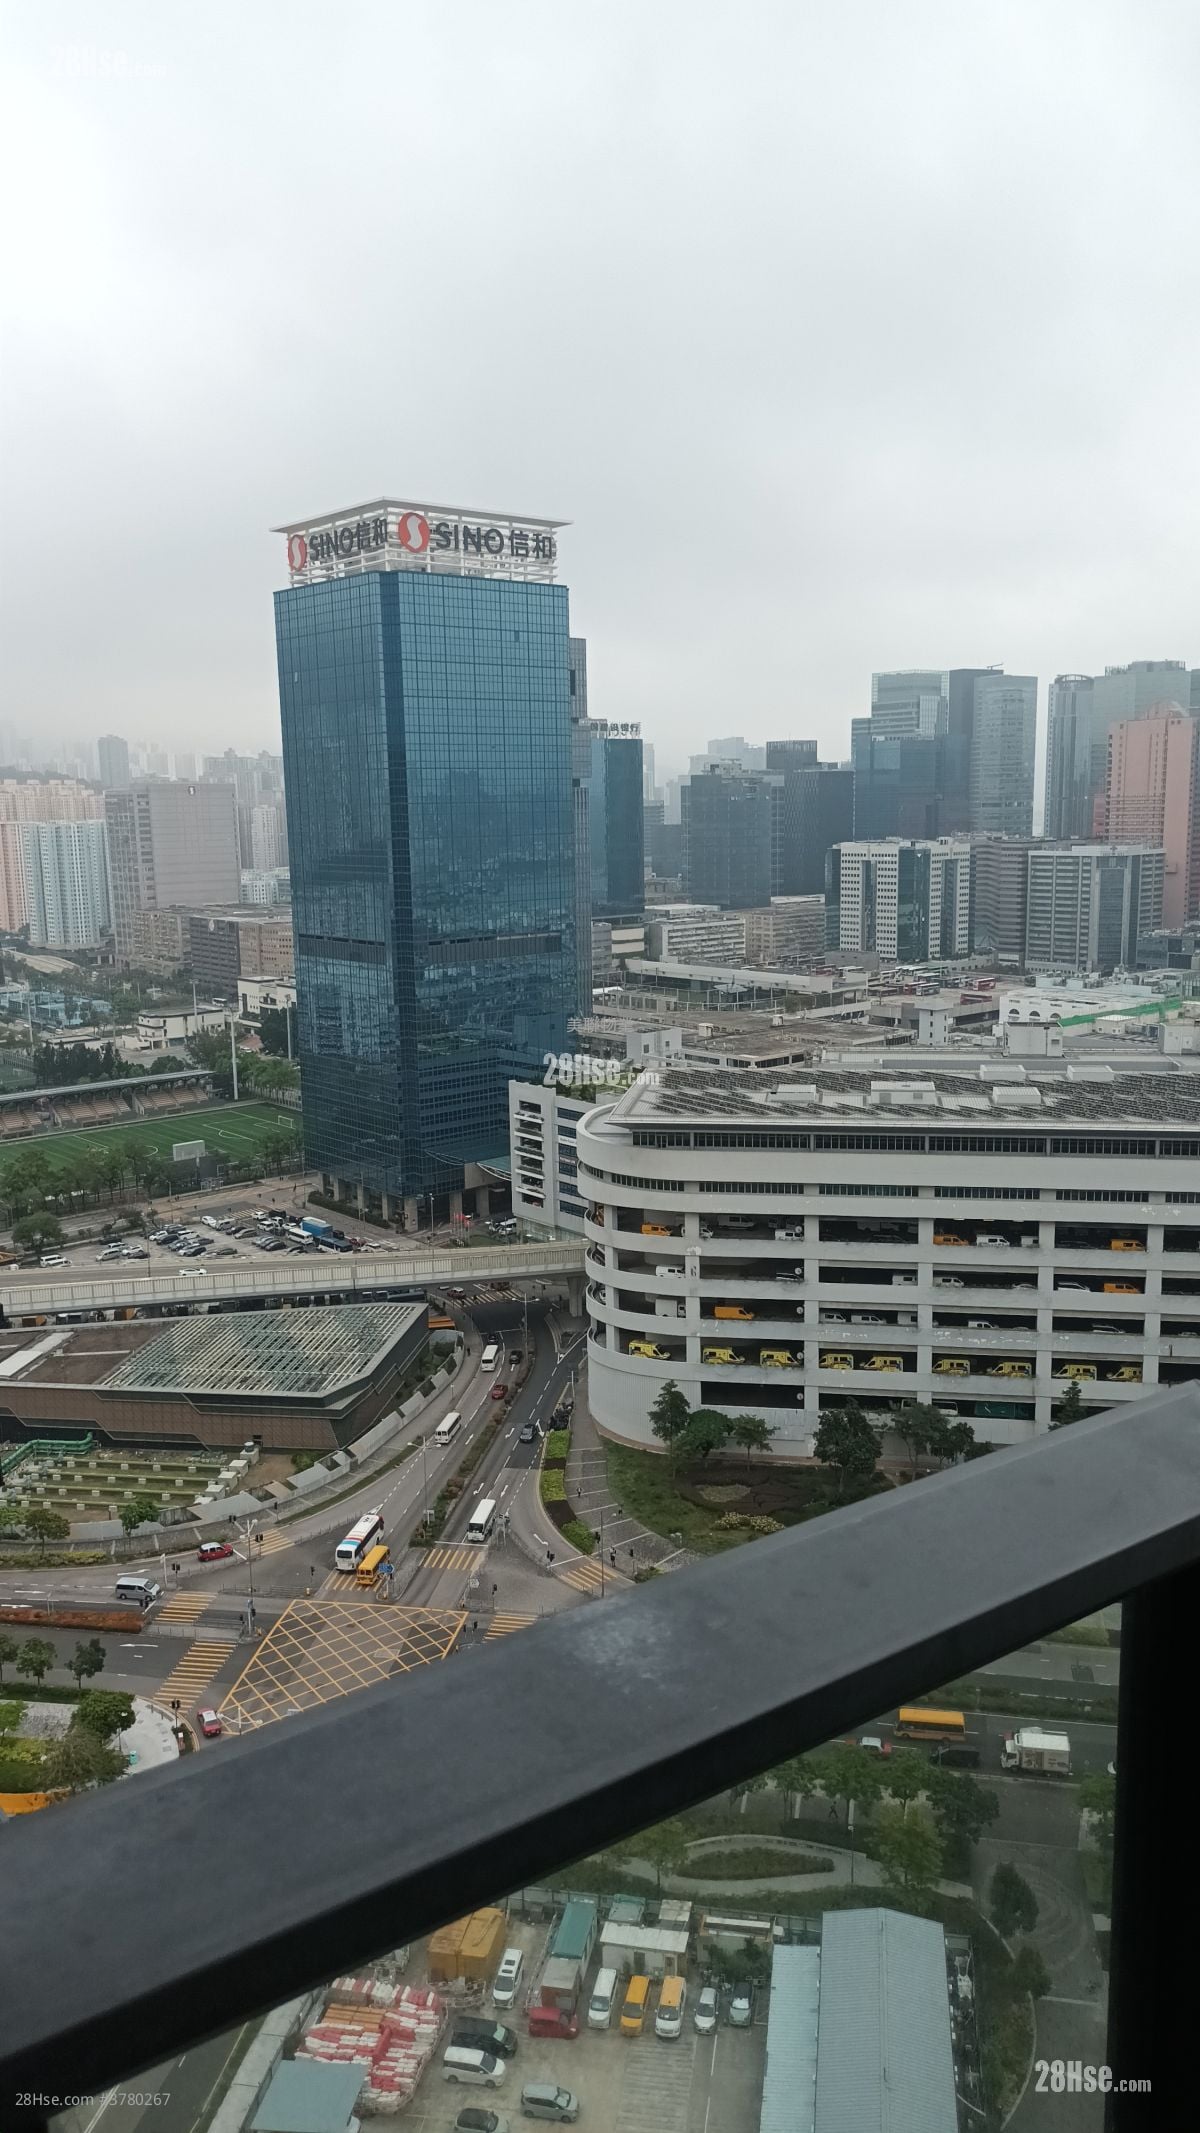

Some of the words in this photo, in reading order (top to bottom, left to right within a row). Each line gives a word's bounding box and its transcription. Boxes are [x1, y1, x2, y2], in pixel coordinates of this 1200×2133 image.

[309, 527, 353, 560] SINO
[435, 522, 505, 554] SINO
[508, 529, 553, 559] 信和
